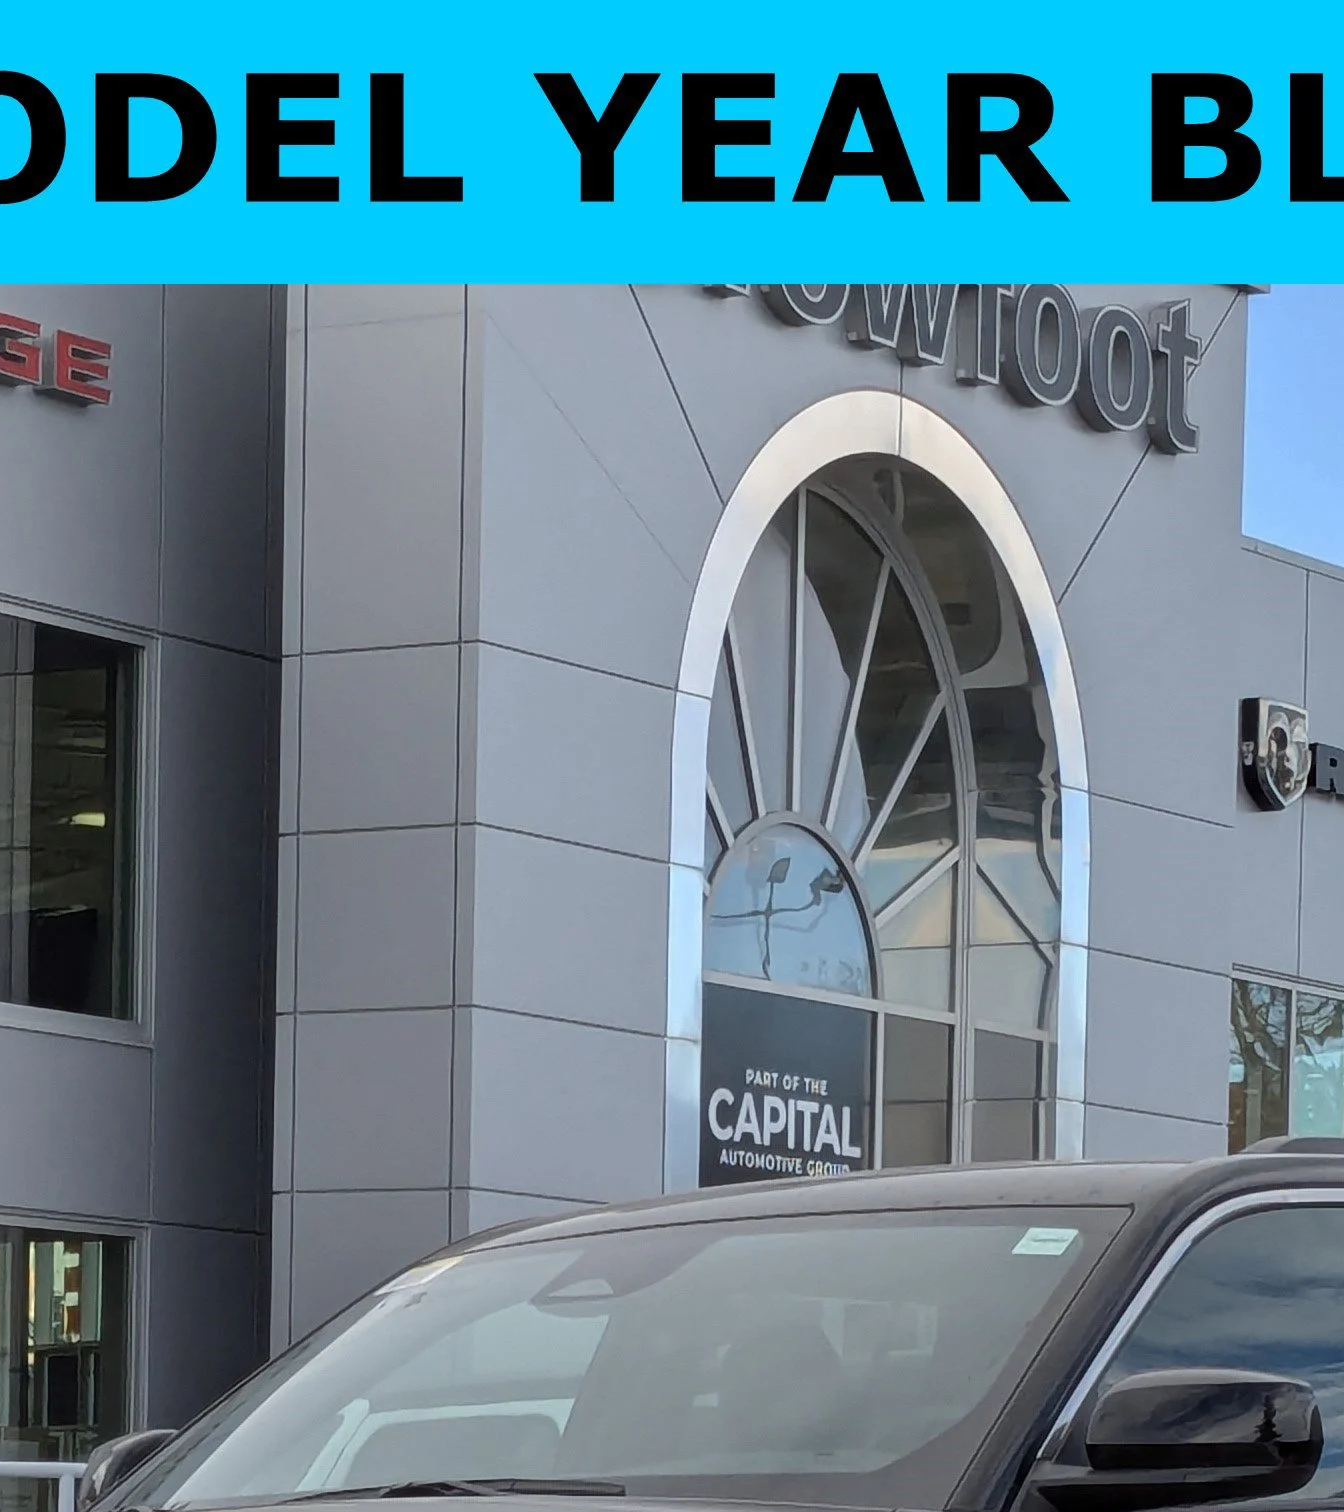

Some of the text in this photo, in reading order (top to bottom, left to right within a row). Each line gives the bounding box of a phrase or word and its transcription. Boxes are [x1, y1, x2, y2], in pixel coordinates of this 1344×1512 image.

[745, 1068, 828, 1096] PART OF THE
[708, 1087, 861, 1158] CAPITAL
[719, 1149, 803, 1175] AUTOMOTIVE
